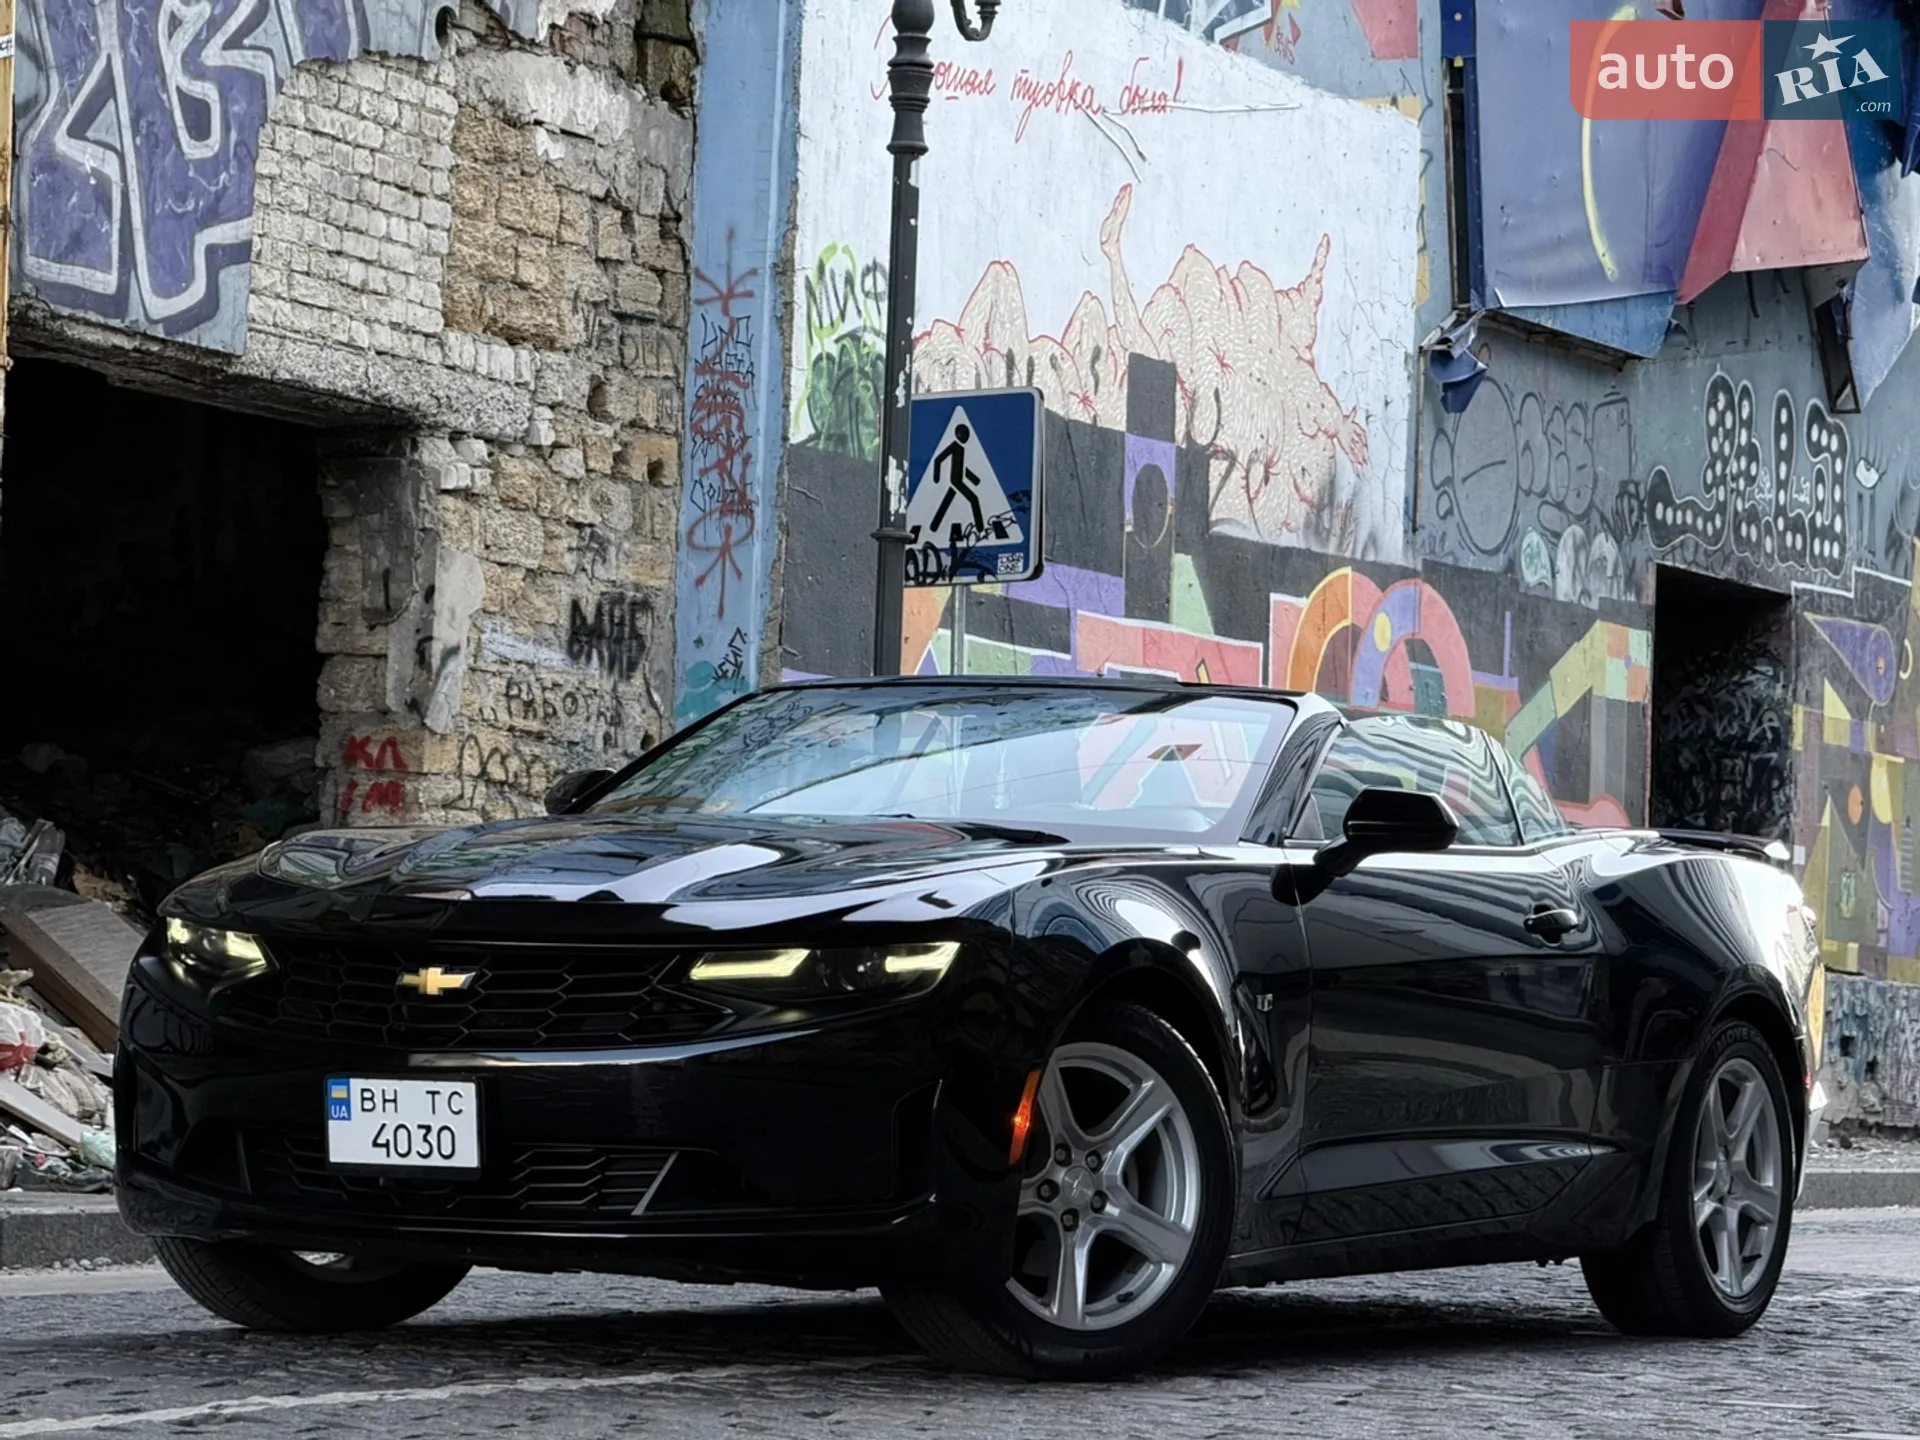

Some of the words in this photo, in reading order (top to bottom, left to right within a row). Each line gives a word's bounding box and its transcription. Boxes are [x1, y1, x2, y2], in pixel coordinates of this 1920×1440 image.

[1011, 49, 1102, 144] тусовка
[331, 1105, 349, 1119] UA
[360, 1087, 398, 1113] BH
[425, 1090, 463, 1115] TC
[371, 1123, 456, 1160] 4030
